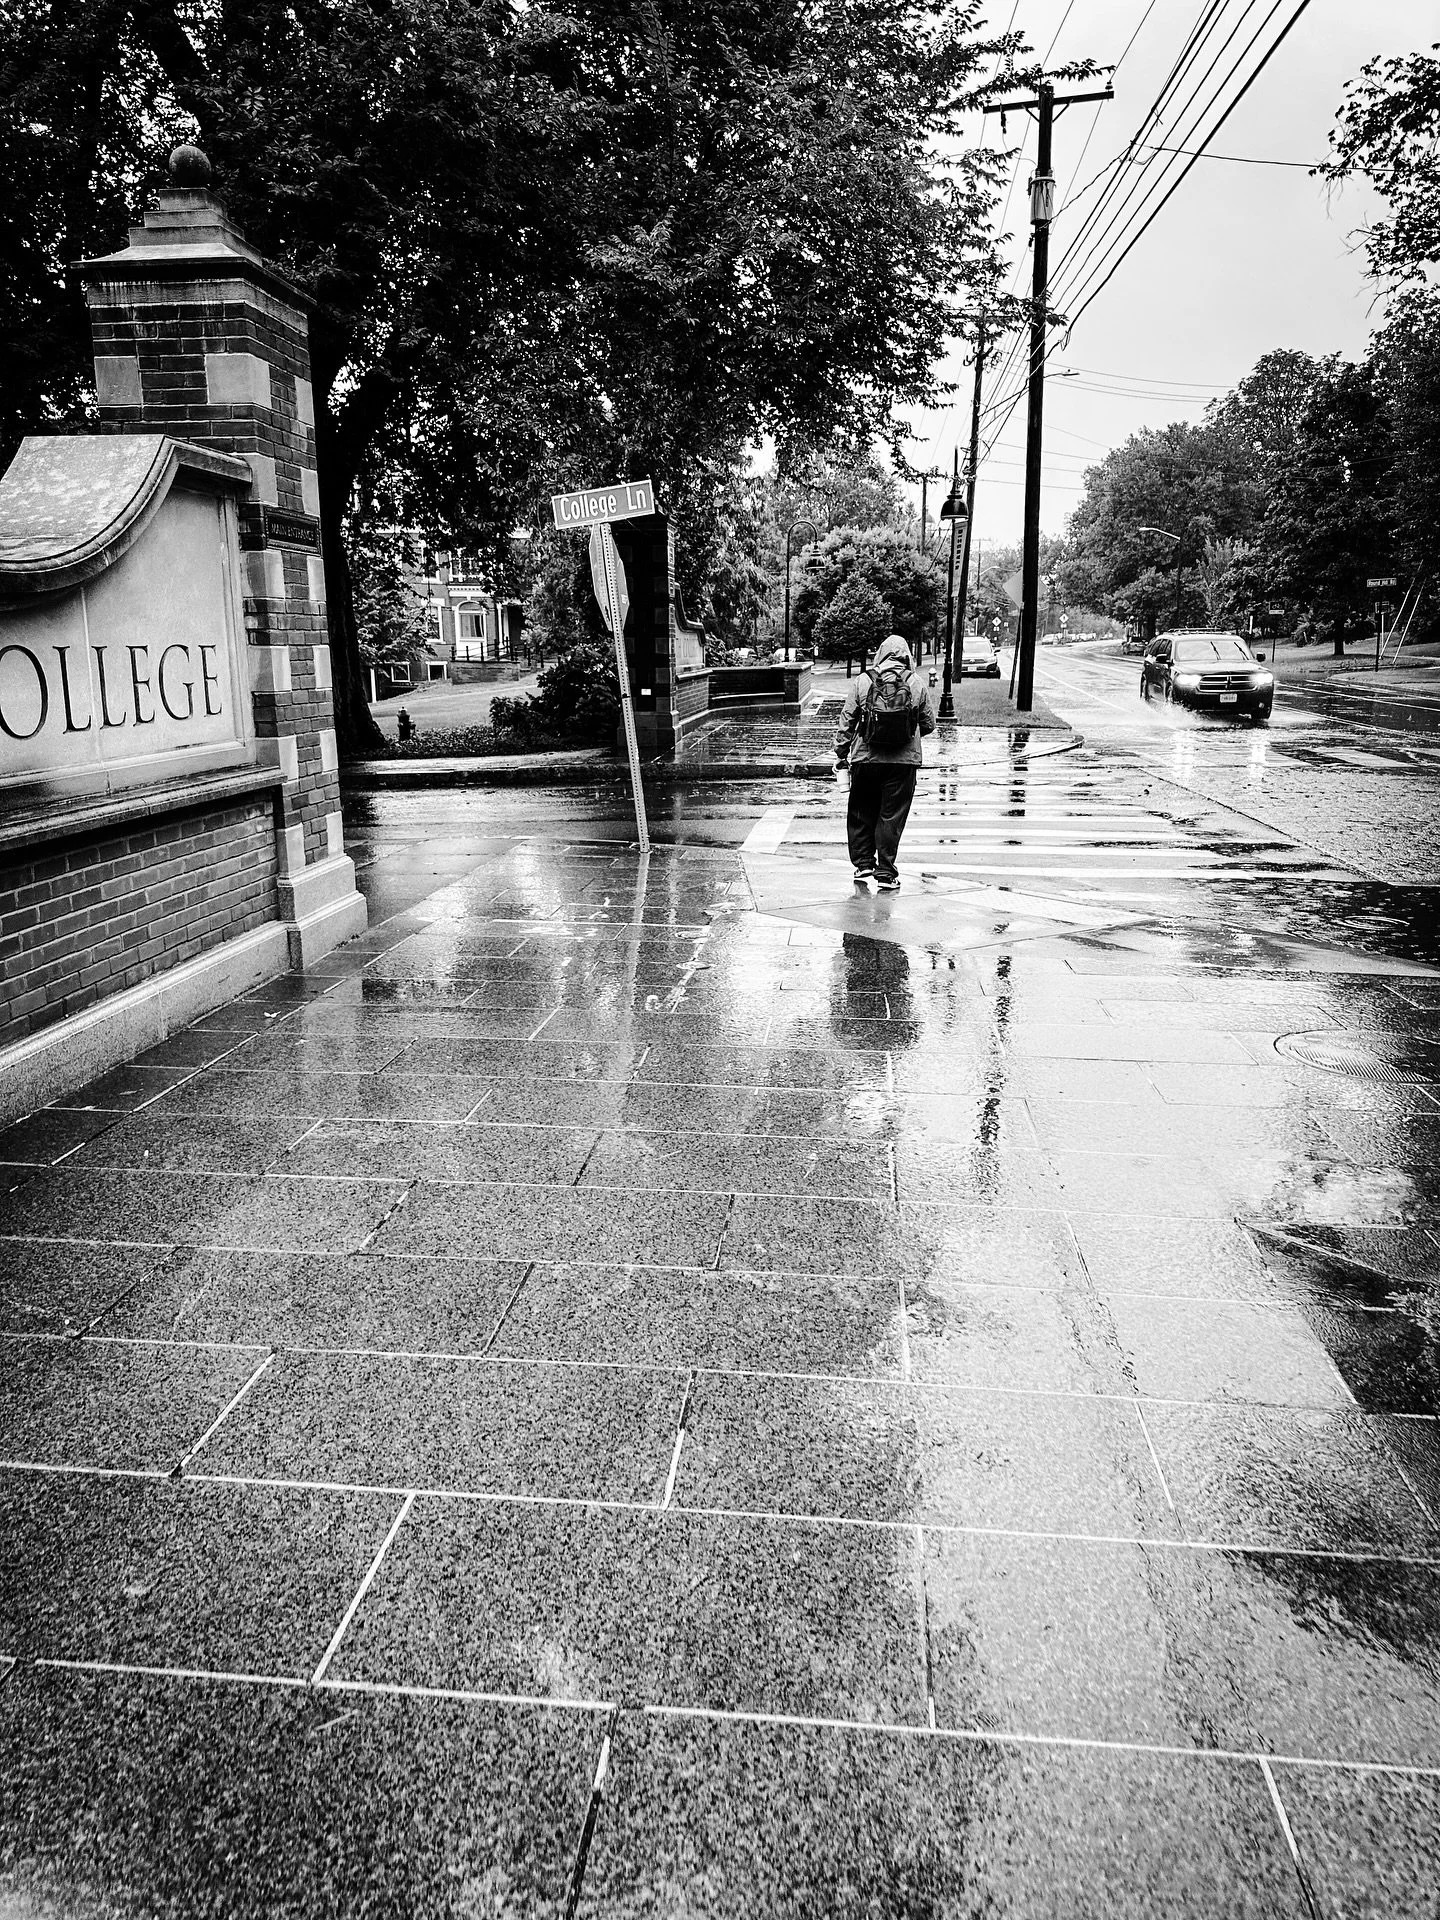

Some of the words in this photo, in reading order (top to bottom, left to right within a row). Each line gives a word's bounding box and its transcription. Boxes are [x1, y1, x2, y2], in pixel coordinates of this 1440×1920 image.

[560, 494, 616, 520] College
[626, 487, 646, 510] Ln
[0, 643, 223, 739] OLLEGE
